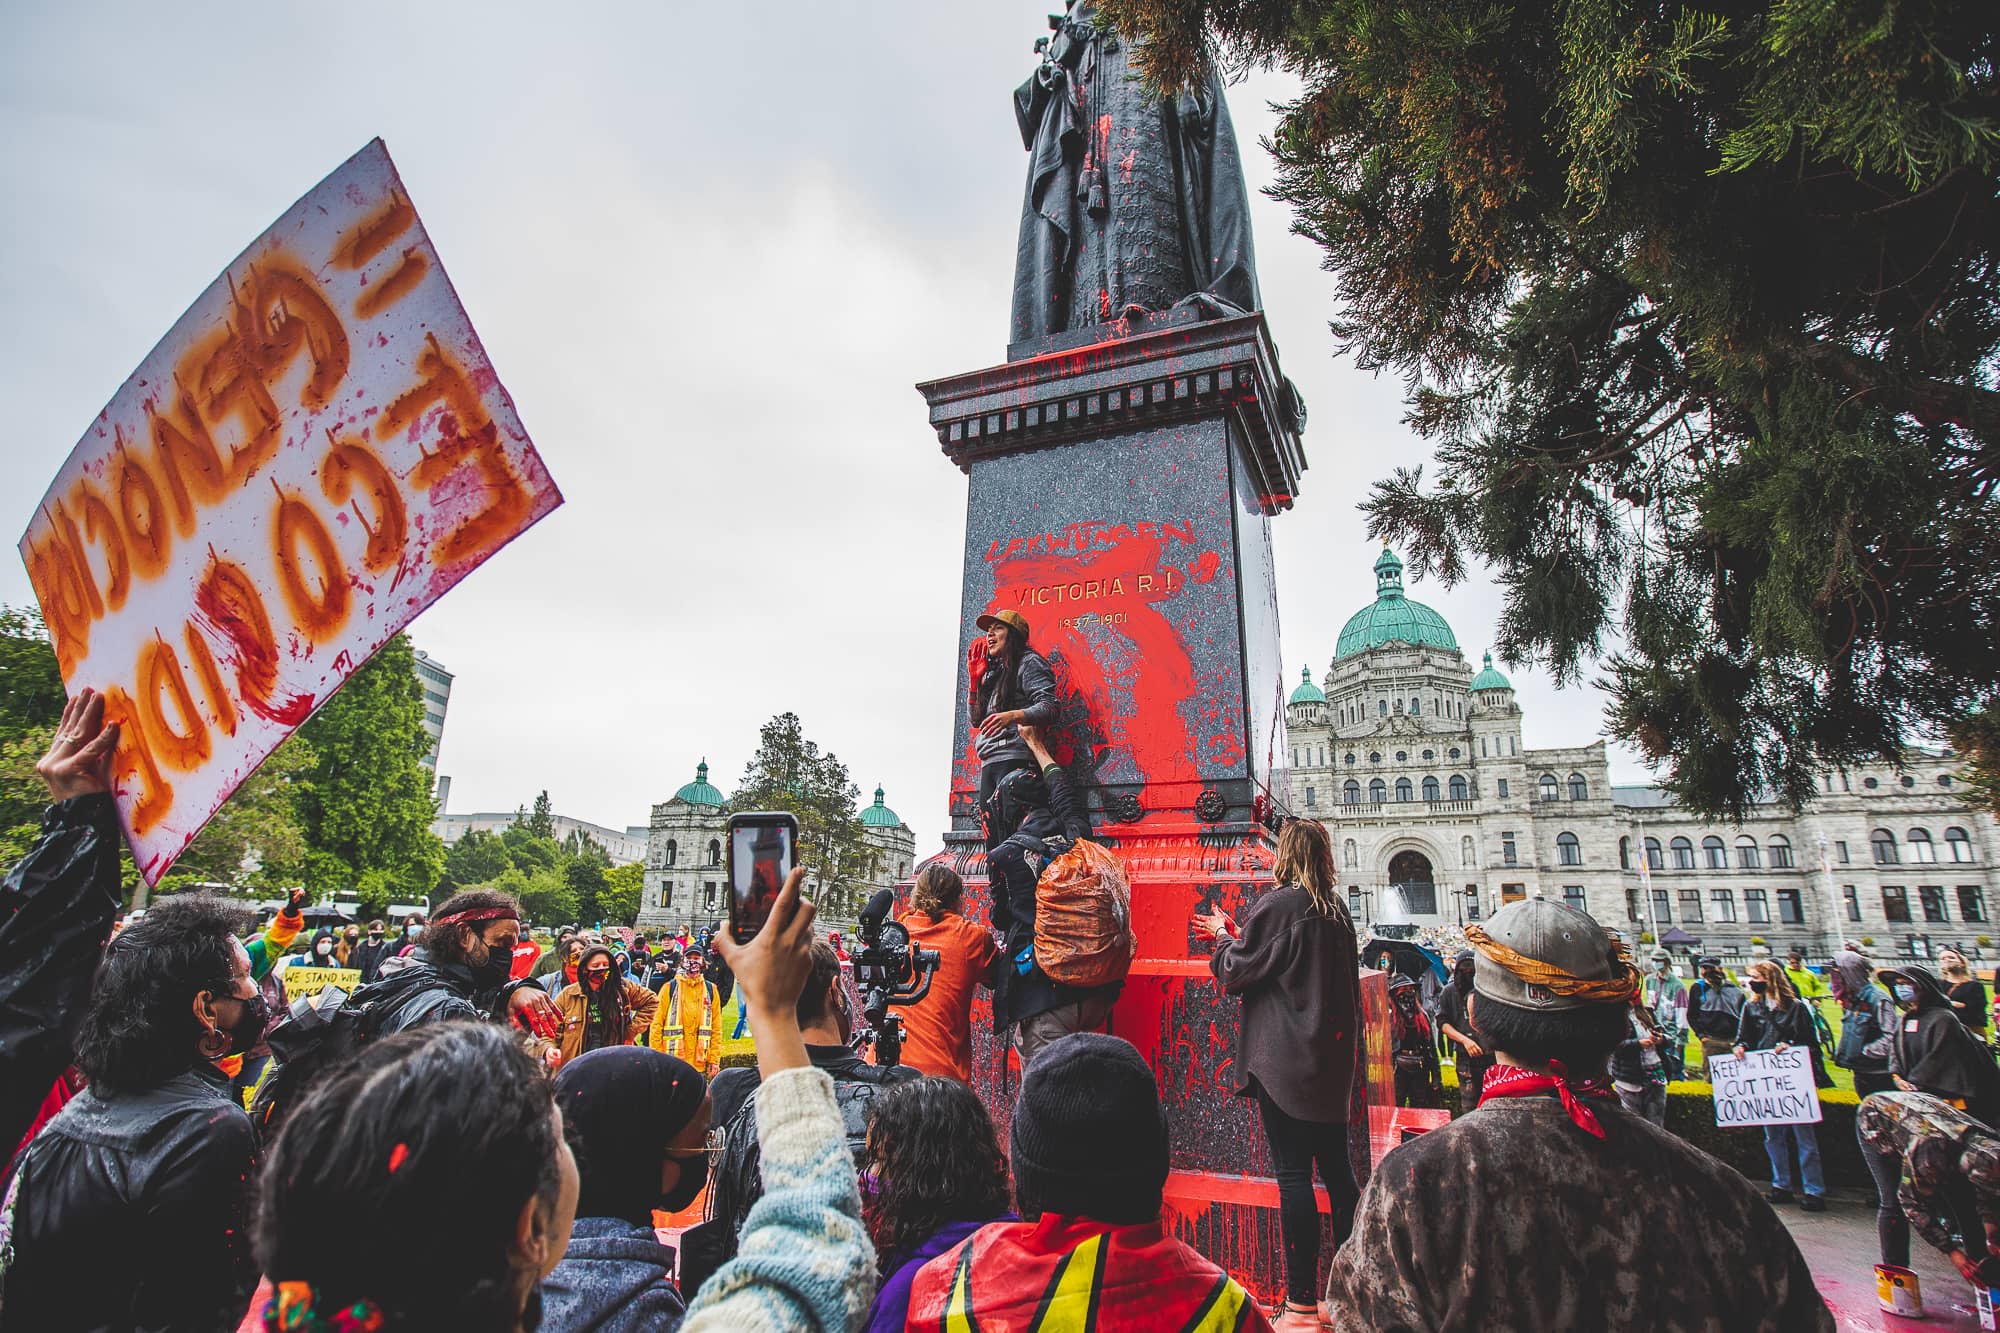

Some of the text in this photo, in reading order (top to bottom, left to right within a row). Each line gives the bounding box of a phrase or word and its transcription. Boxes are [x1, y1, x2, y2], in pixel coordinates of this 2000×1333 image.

[1014, 577, 1124, 606] VICTORIA
[285, 972, 300, 983] WE
[305, 972, 337, 983] STAND
[1757, 1051, 1801, 1070] TREES
[1724, 1075, 1796, 1099] CUT THE
[1716, 1091, 1814, 1122] COLONIALISM
